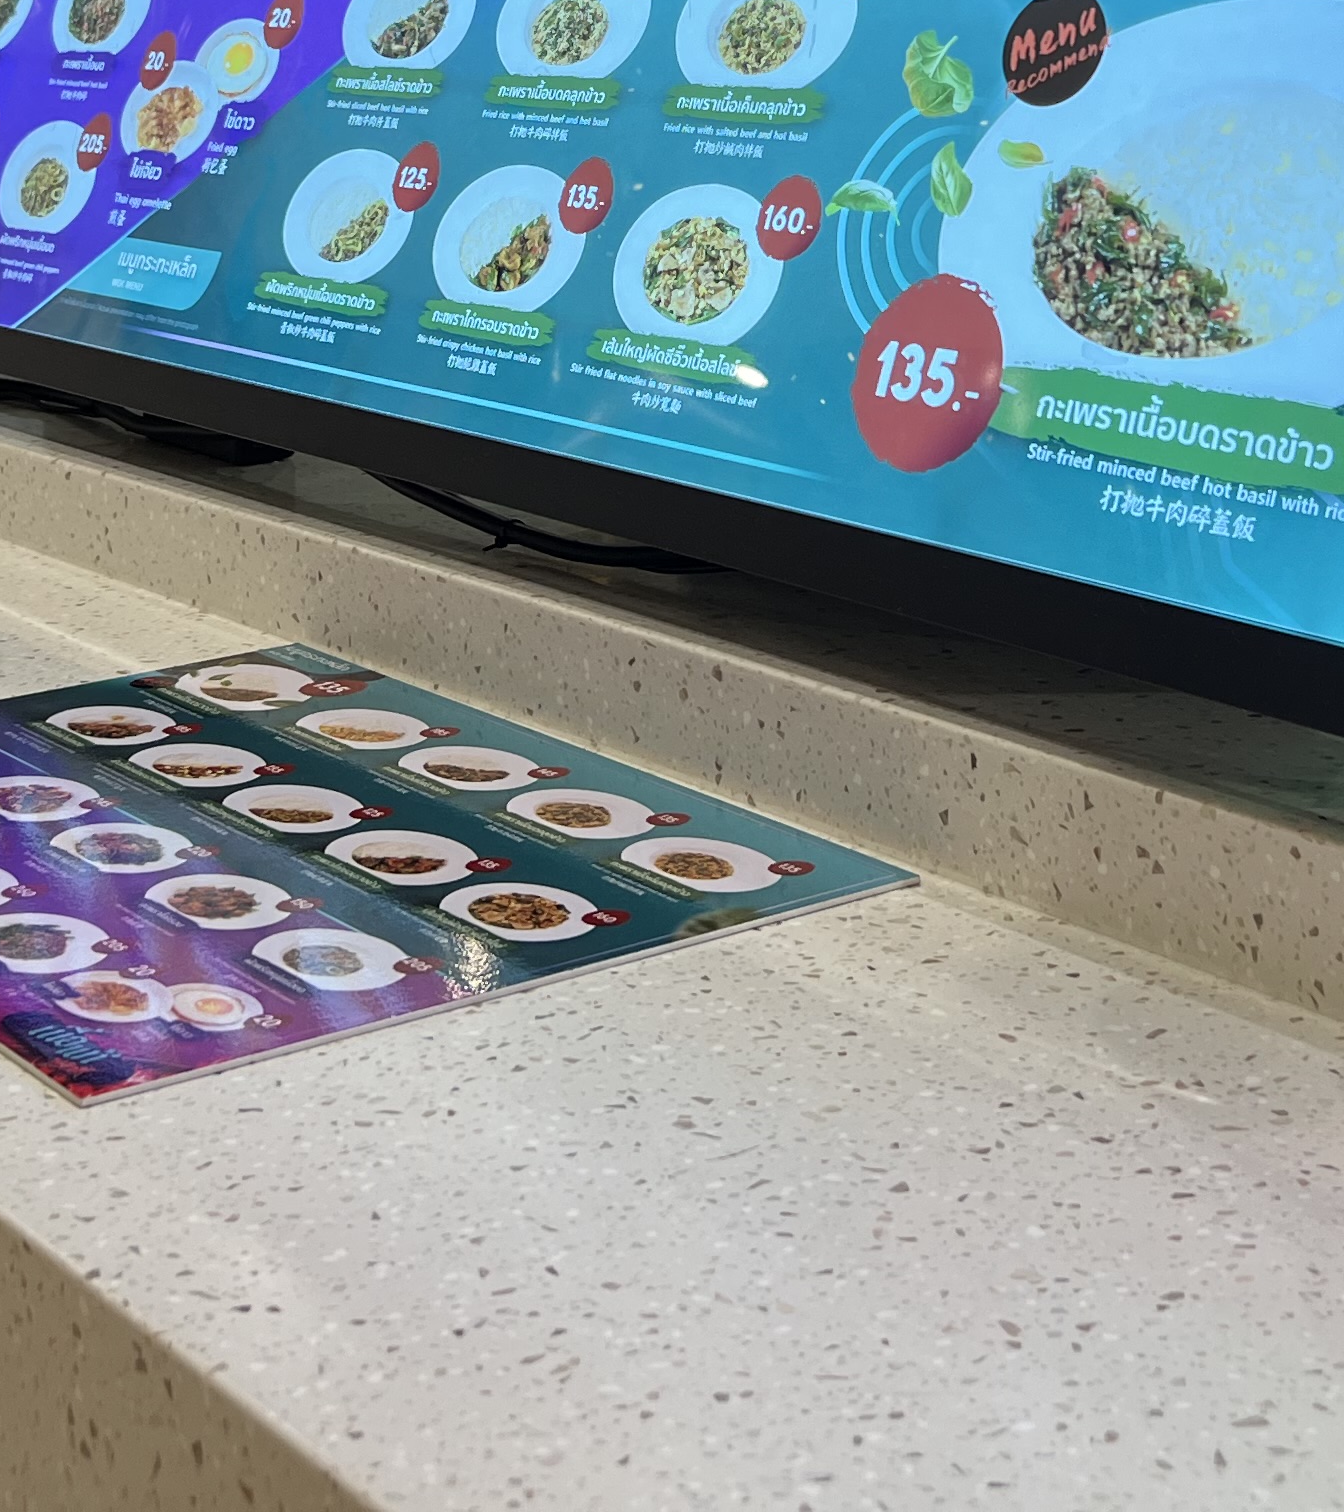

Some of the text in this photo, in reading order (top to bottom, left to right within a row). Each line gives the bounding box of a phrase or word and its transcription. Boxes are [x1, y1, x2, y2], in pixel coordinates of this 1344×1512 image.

[1009, 7, 1097, 73] Menu
[1005, 27, 1112, 98] Recommend
[223, 108, 255, 131] ไข่ดาว
[681, 124, 696, 134] rice
[757, 130, 773, 139] and
[566, 185, 605, 211] 135.-
[763, 204, 814, 235] 160.-
[117, 252, 197, 279] เมนูกระทะเหล็ก
[874, 340, 980, 412] 135.-
[648, 378, 657, 388] in
[657, 381, 672, 393] soy
[695, 388, 713, 400] with
[738, 396, 758, 409] beef
[1036, 394, 1334, 471] กะเพราเนื้อบดราดข้าว
[1027, 442, 1094, 471] Stir-fried
[1096, 457, 1156, 484] minced
[1159, 469, 1200, 492] beef
[1203, 477, 1233, 500] hot
[1236, 484, 1277, 508] basil
[1281, 493, 1320, 517] with
